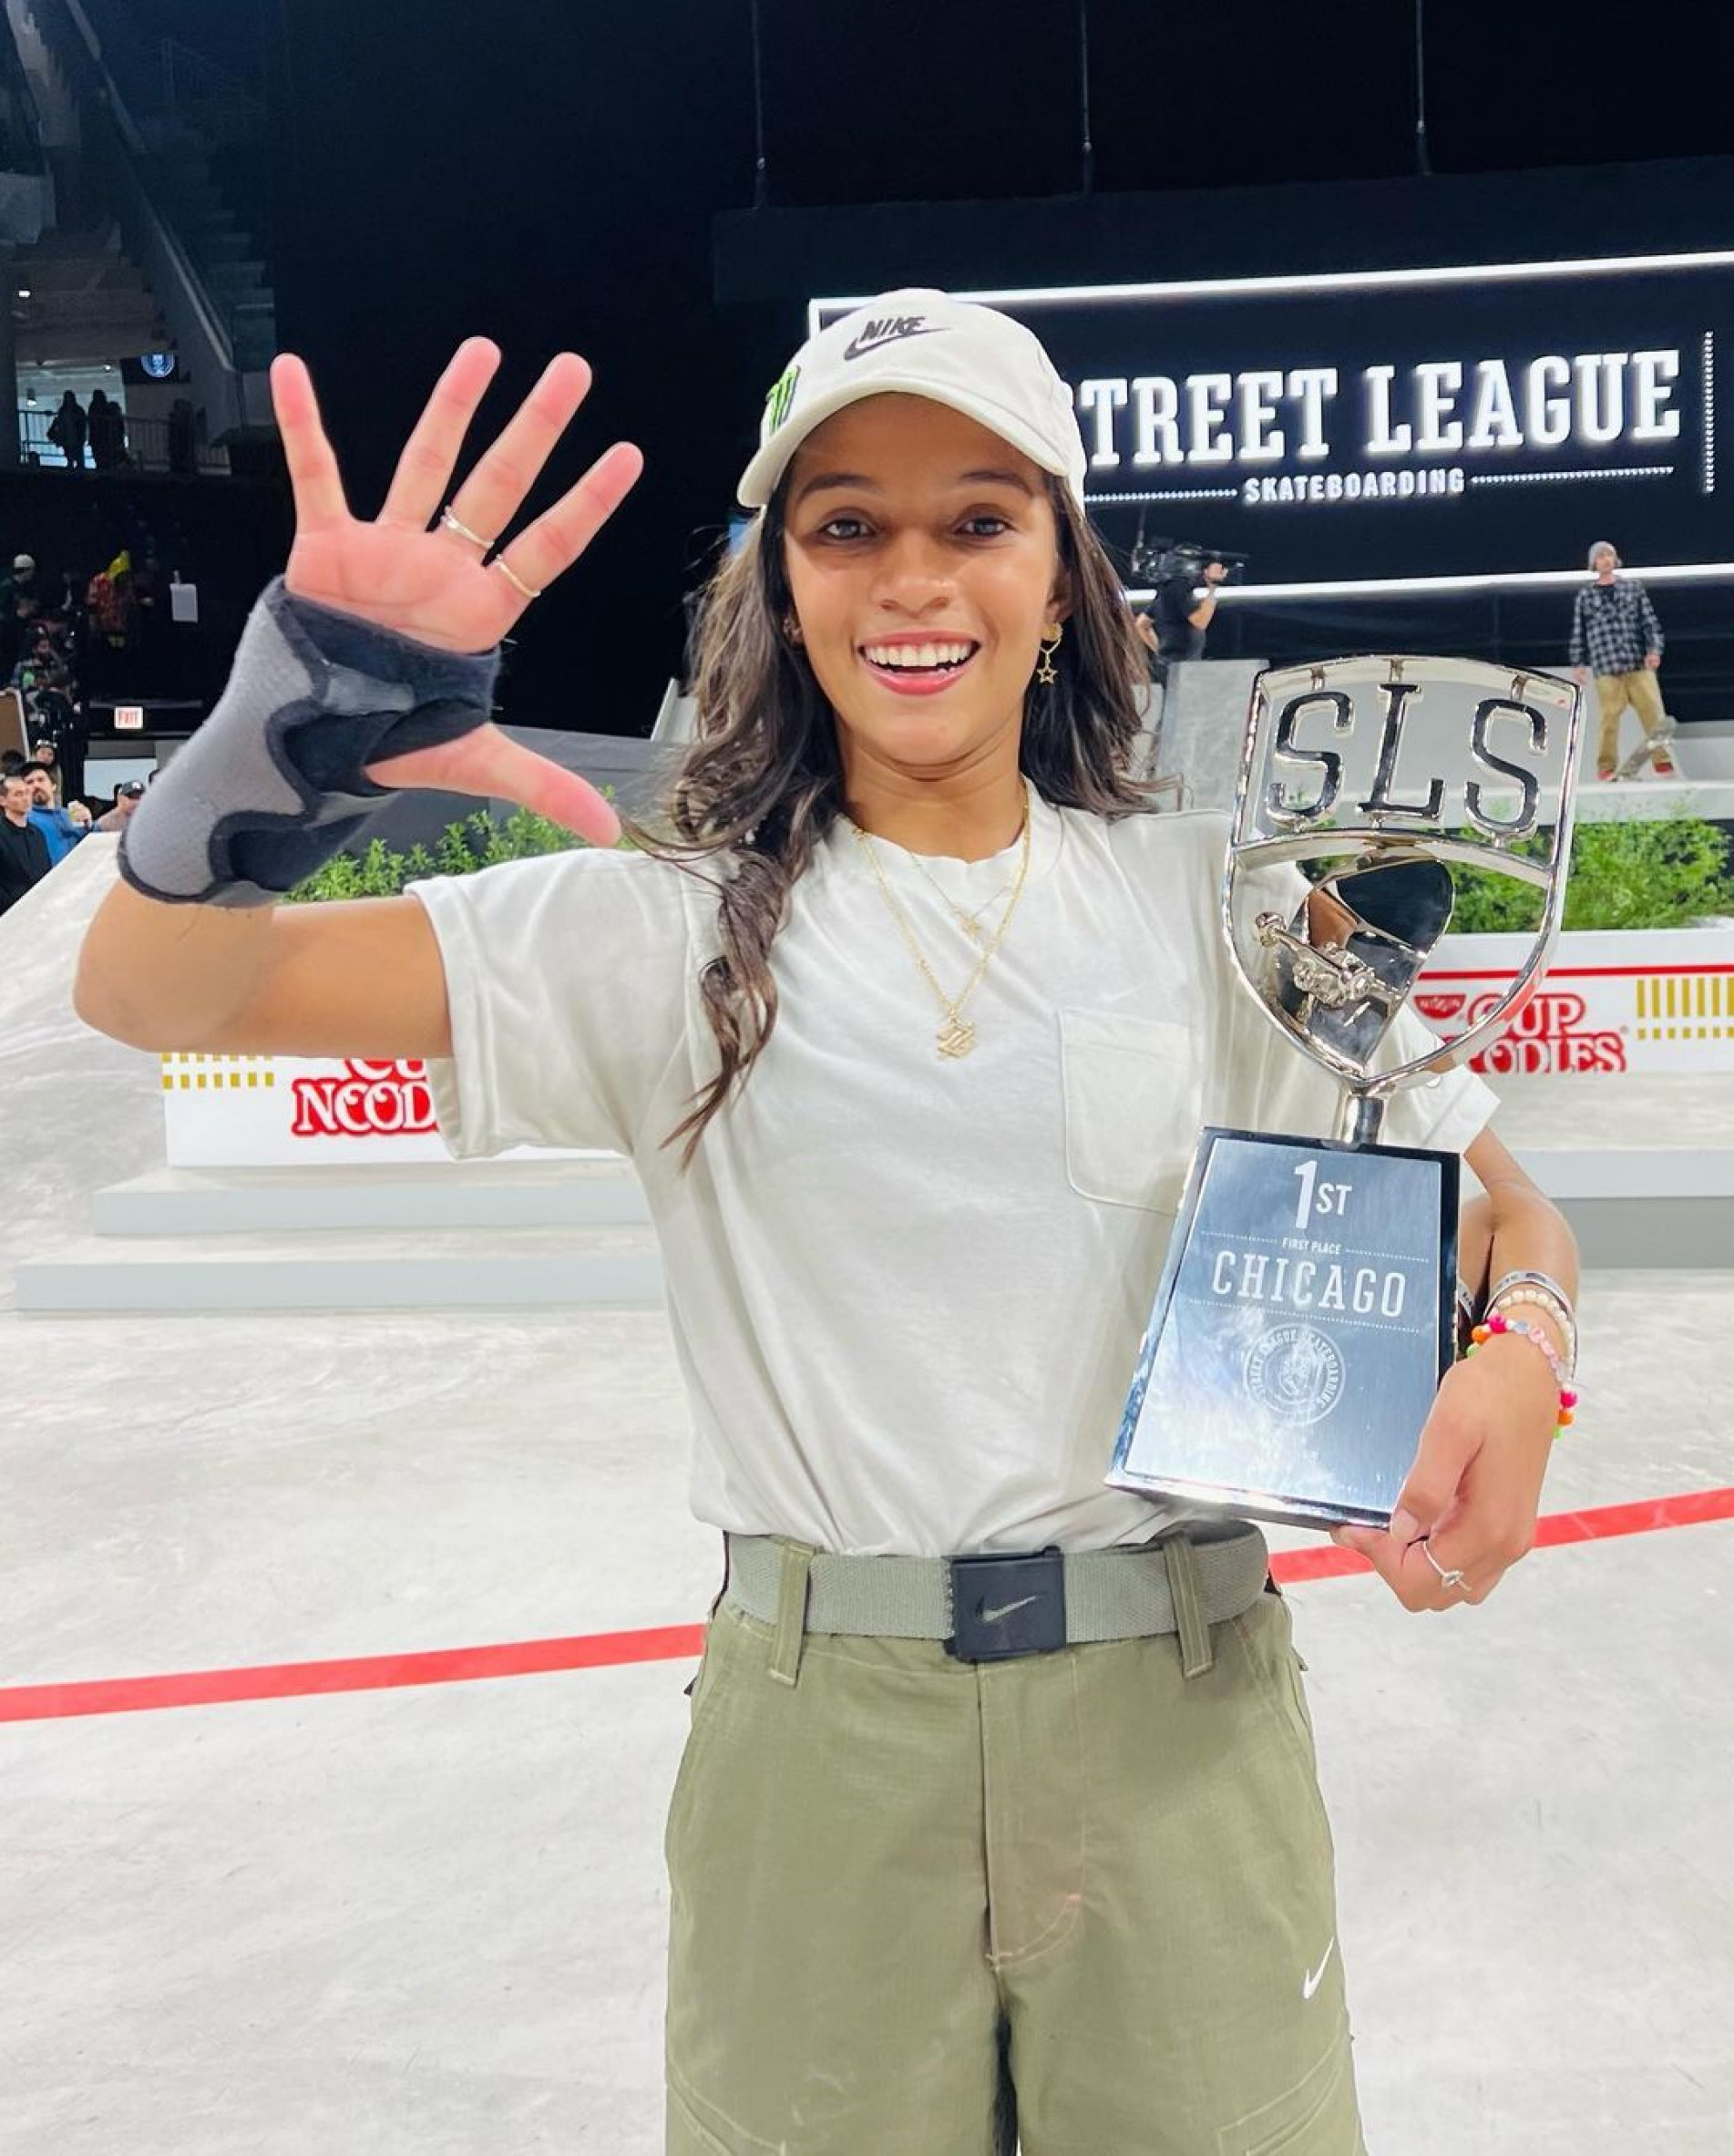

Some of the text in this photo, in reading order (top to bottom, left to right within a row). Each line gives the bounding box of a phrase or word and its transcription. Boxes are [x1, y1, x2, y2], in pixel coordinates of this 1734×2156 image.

[858, 315, 926, 342] NIKE
[1080, 350, 1680, 466] TREET LEAGUE
[1244, 467, 1465, 503] SKATEBOARDING
[118, 711, 139, 725] EXIT
[1266, 683, 1548, 837] SLS
[1470, 1037, 1624, 1073] ODLES
[294, 1080, 436, 1134] NOOD
[1294, 1160, 1353, 1229] 1ST
[1282, 1237, 1342, 1256] FIRST PLACE
[1212, 1249, 1407, 1318] CHICAGO
